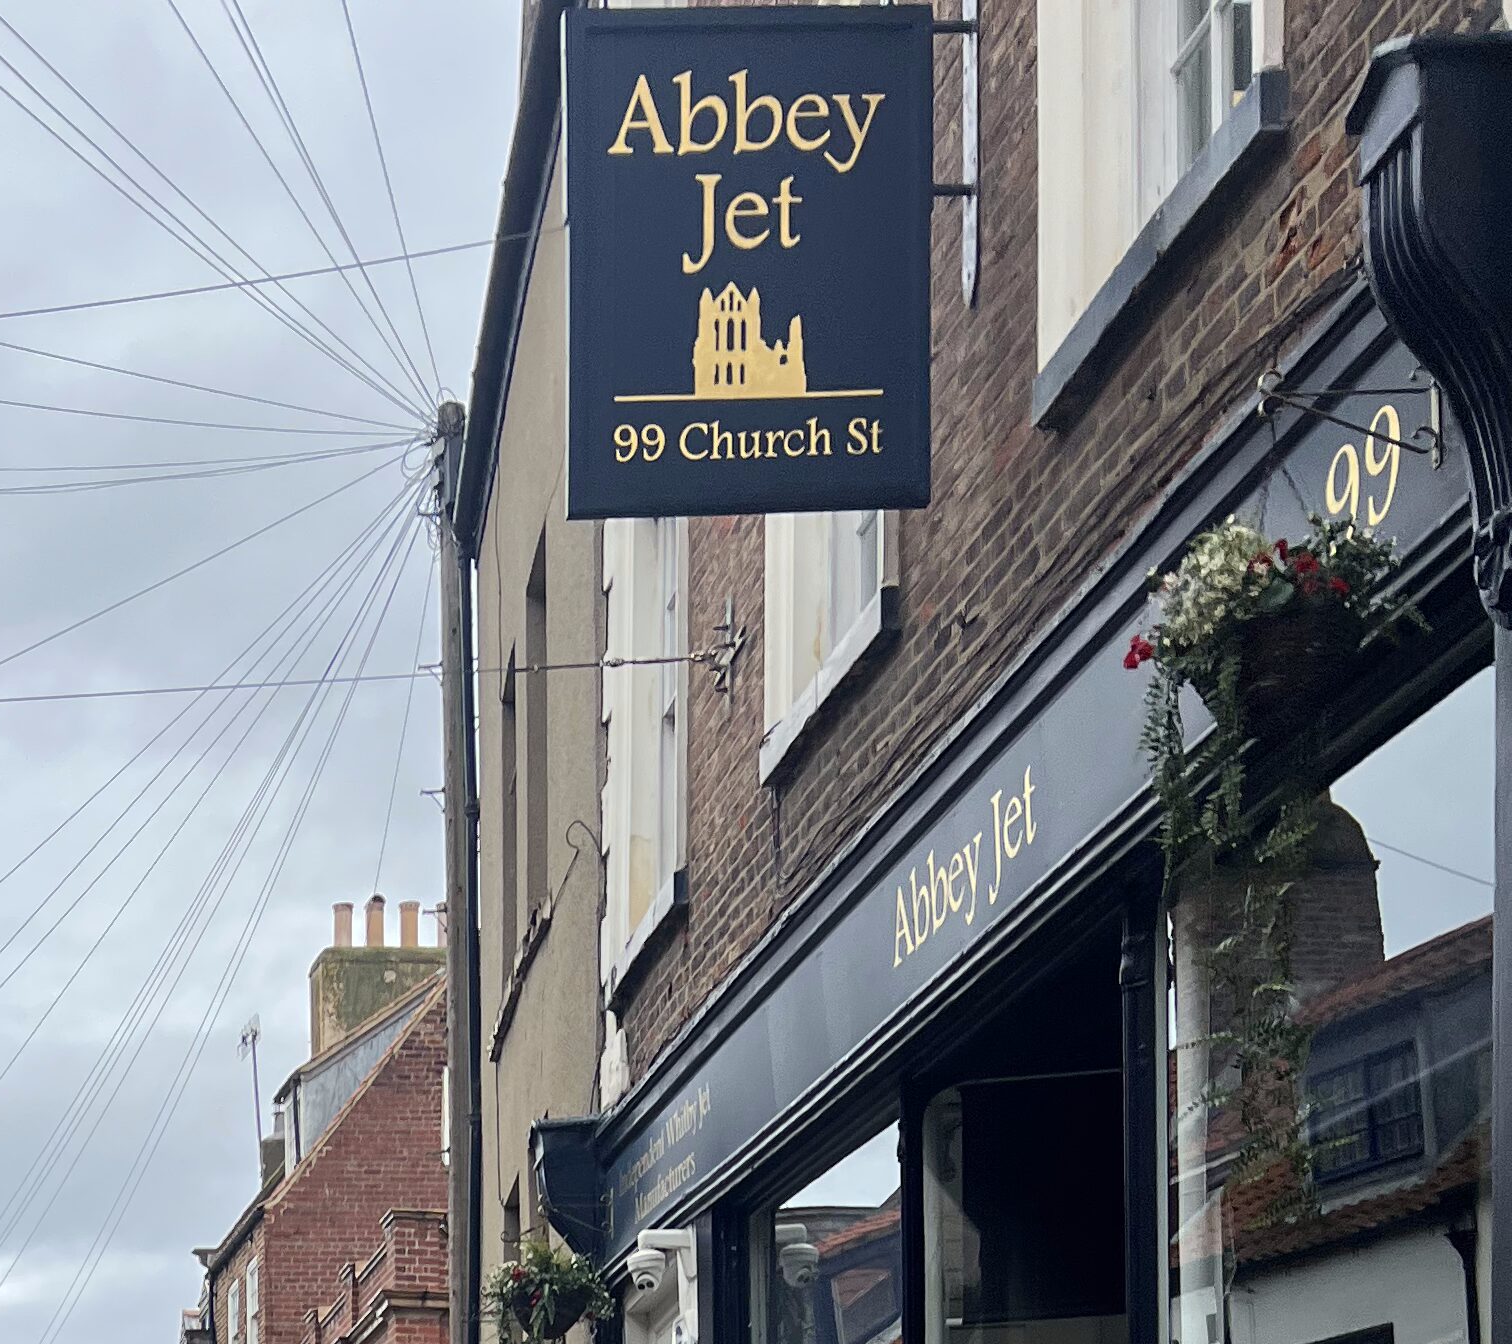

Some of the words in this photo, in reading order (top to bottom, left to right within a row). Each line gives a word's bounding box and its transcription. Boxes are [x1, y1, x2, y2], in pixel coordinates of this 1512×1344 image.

[607, 69, 886, 172] Abbey
[682, 173, 803, 274] Jet
[613, 423, 666, 462] 99
[679, 416, 832, 461] Church
[846, 416, 884, 455] St
[1326, 404, 1400, 540] 99
[893, 831, 983, 968] Abbey
[989, 764, 1037, 905] Jet
[666, 1101, 697, 1149] Whitby
[698, 1081, 711, 1130] Jet
